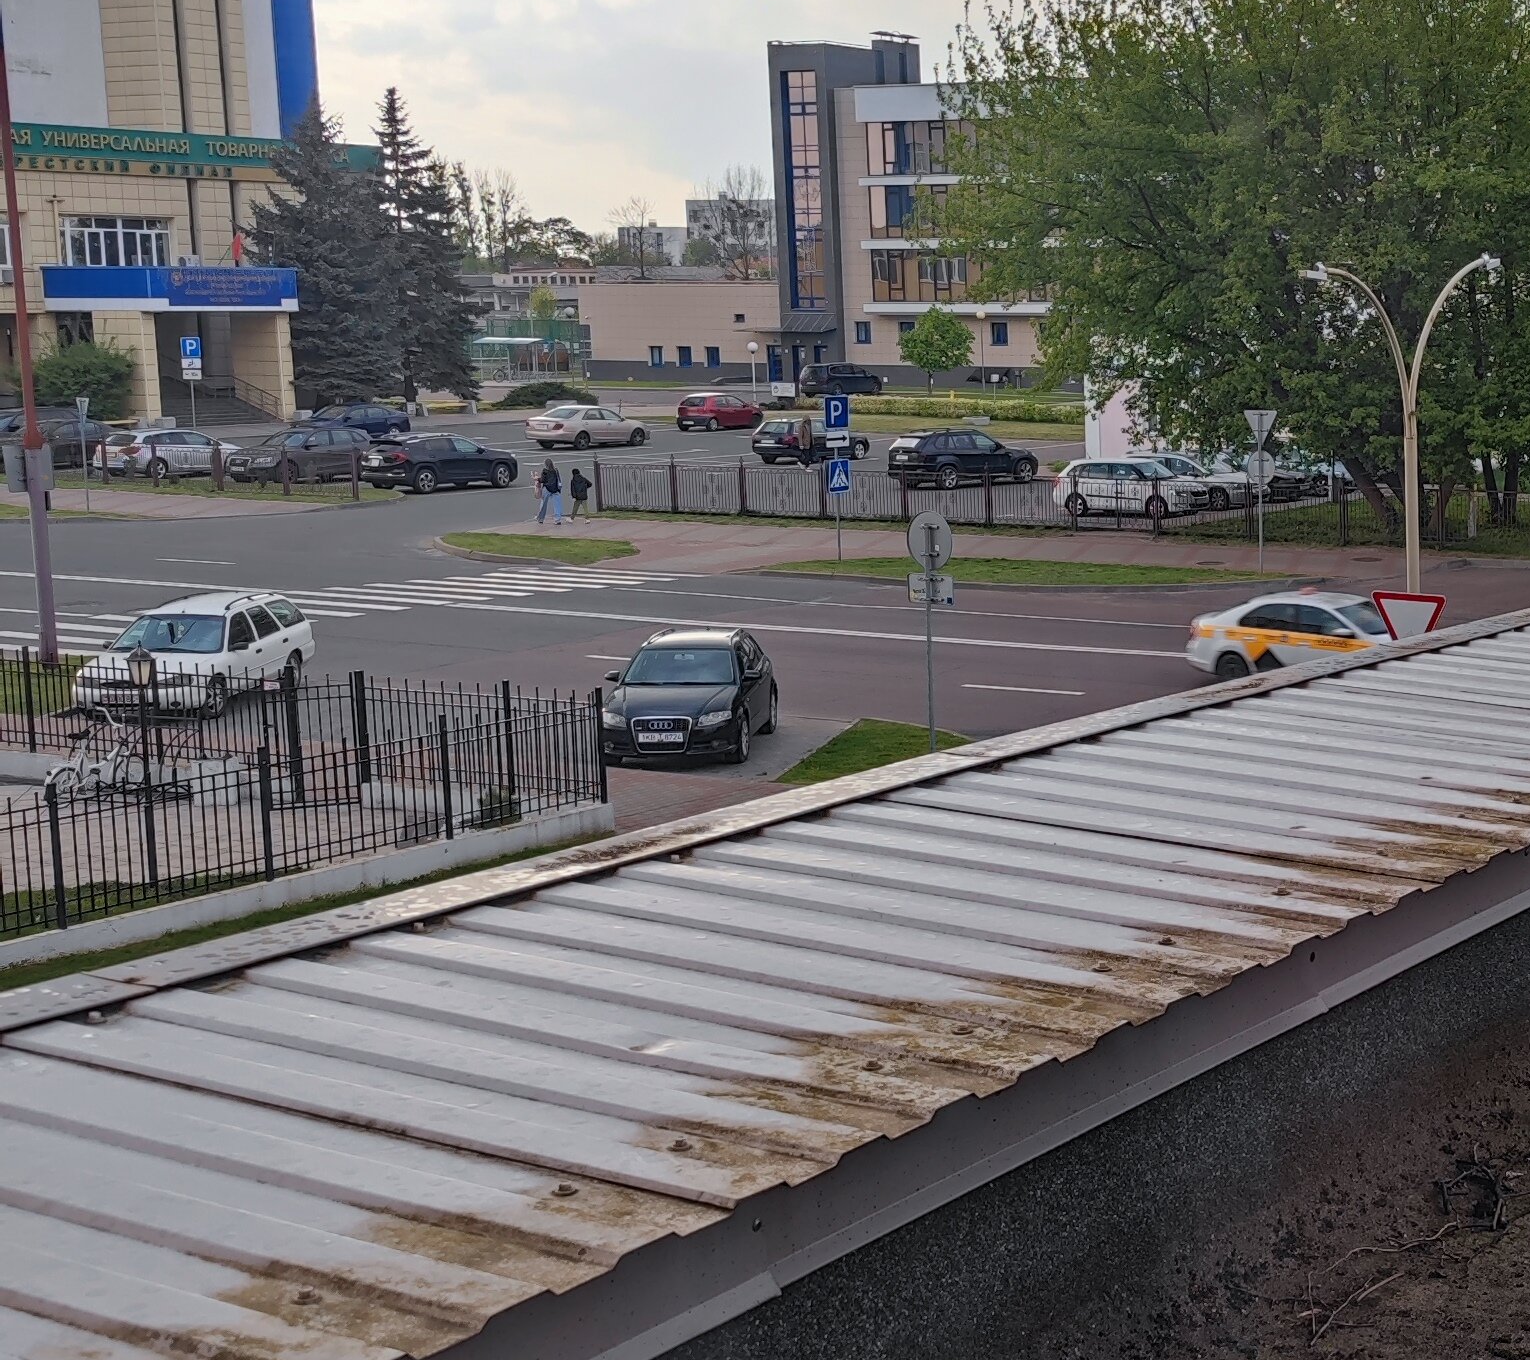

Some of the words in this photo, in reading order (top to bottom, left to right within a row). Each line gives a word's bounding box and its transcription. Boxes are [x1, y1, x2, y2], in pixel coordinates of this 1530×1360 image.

[42, 130, 190, 154] УНИВЕРСАЛЬНАЯ
[13, 155, 130, 174] РЕСТСКИЙ
[186, 339, 196, 355] P
[830, 401, 843, 425] P
